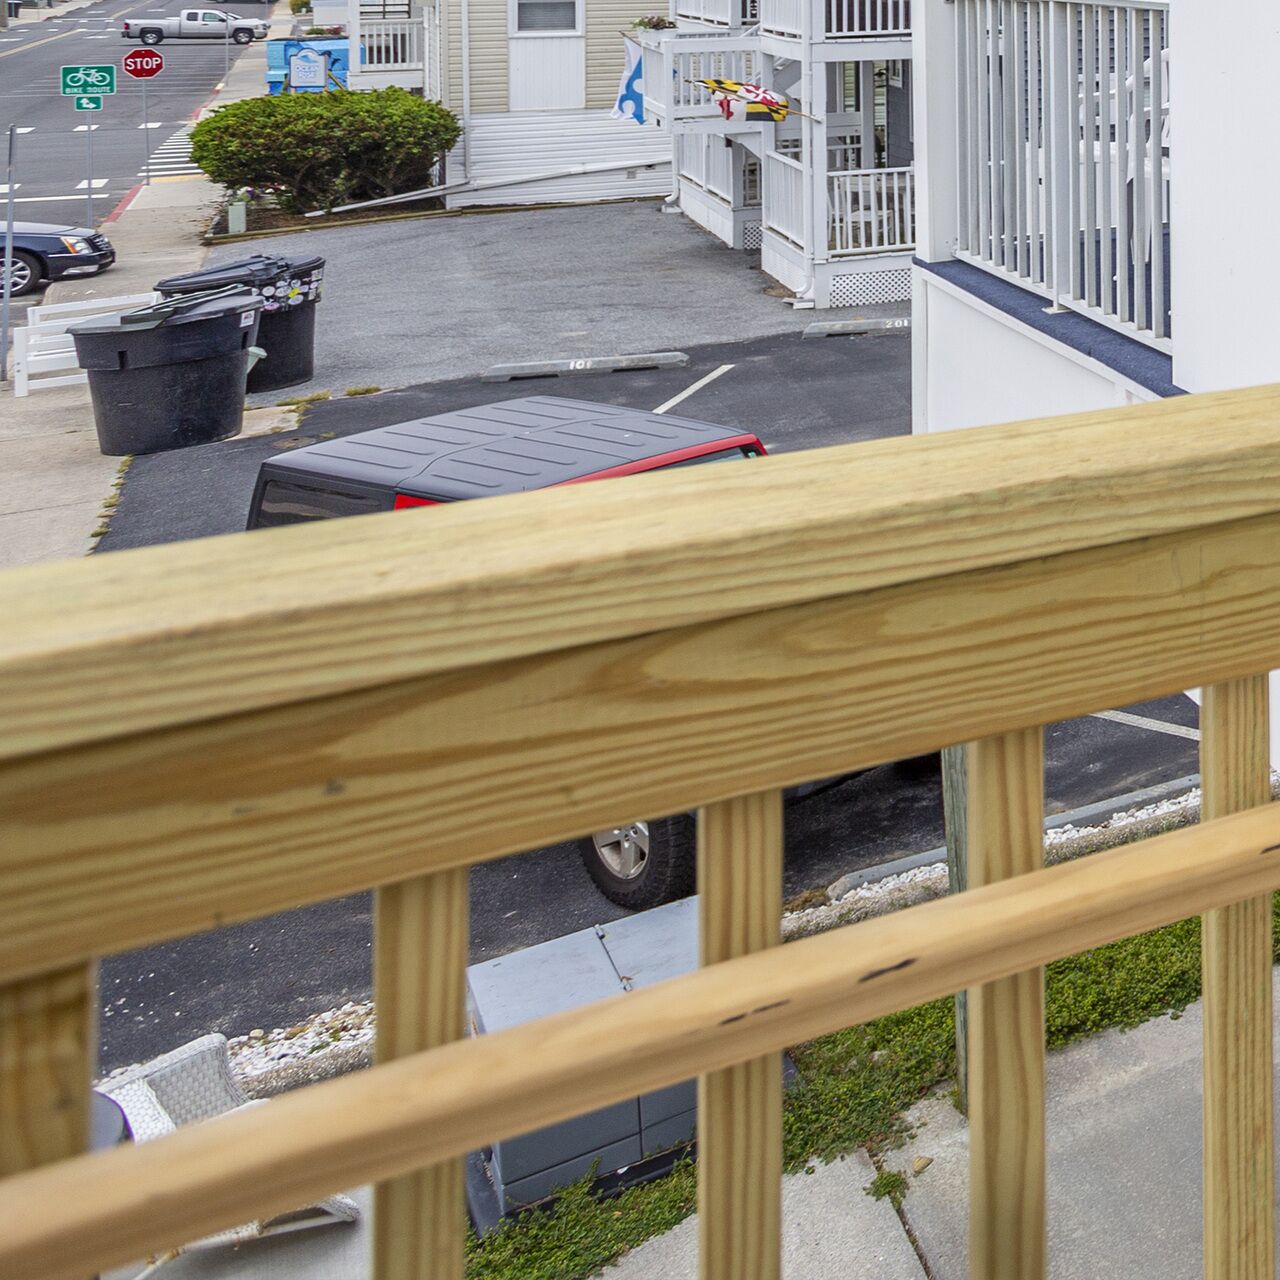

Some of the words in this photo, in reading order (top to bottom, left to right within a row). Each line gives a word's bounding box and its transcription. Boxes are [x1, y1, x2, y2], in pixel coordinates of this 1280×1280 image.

[126, 58, 161, 70] STOP
[884, 319, 908, 328] 201
[569, 359, 593, 370] 101
